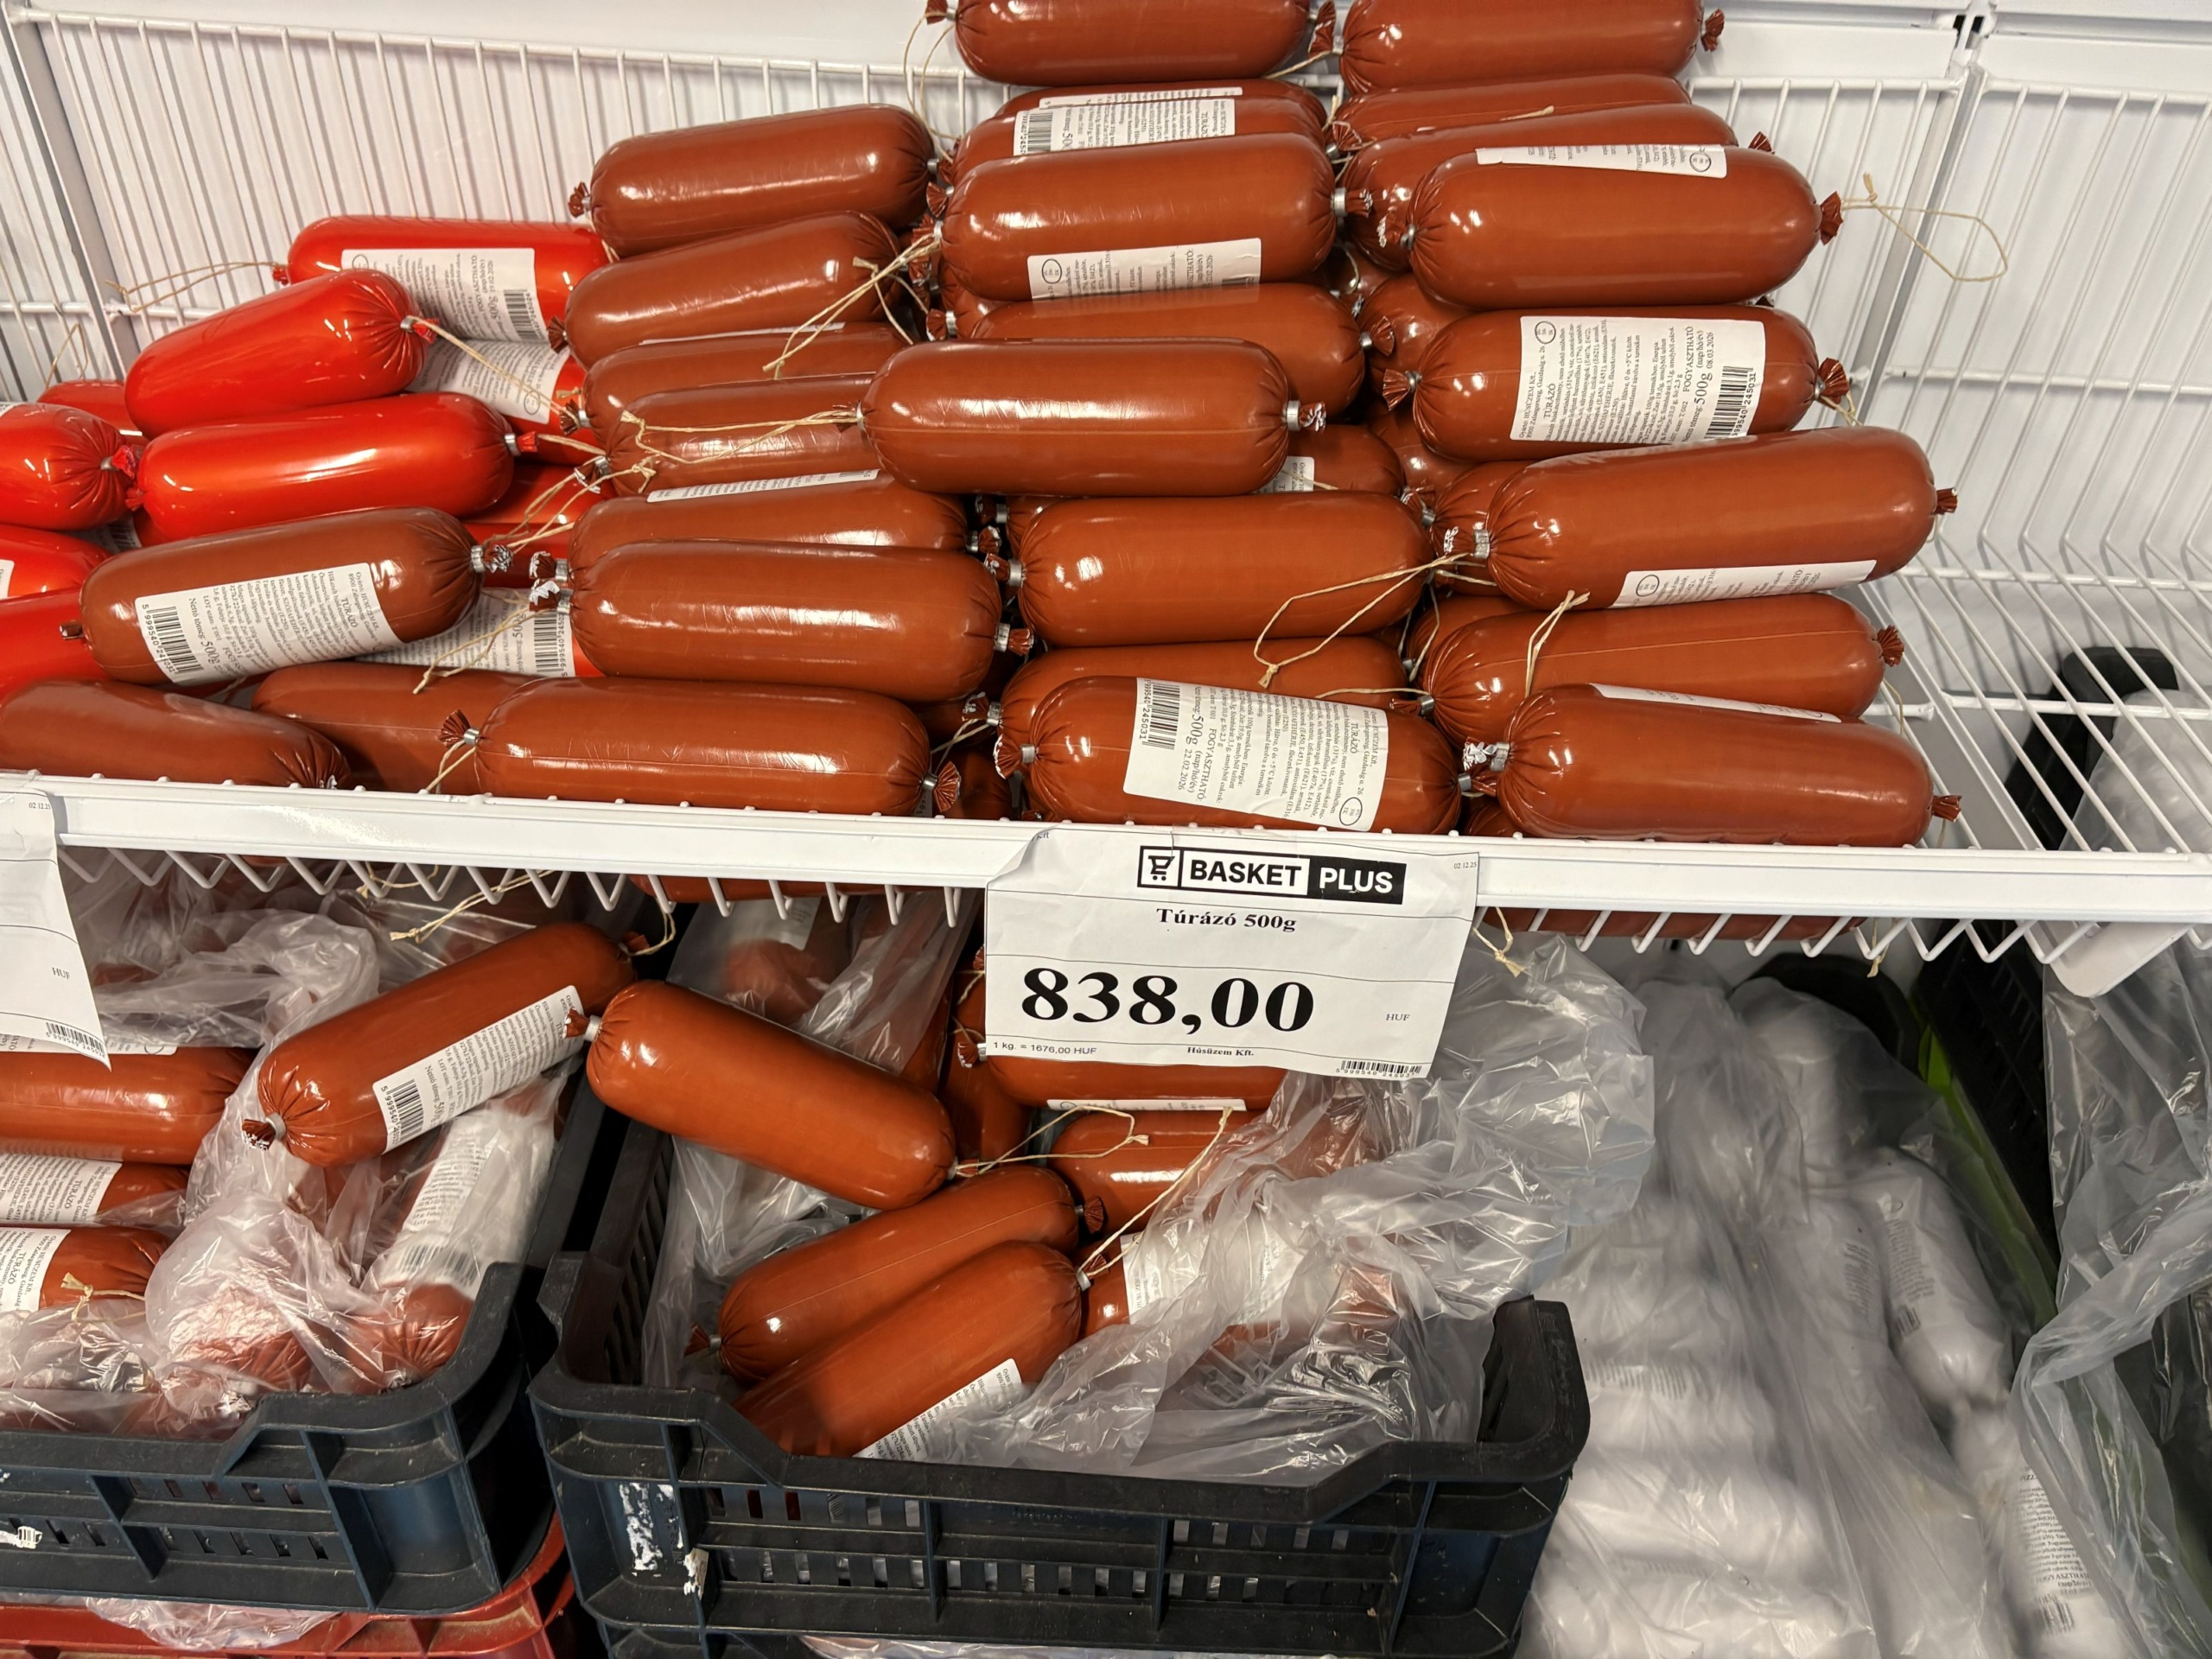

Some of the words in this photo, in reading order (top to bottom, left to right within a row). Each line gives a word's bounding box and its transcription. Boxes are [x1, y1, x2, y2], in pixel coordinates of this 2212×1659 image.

[1705, 331, 1713, 369] 08.03.2026
[1541, 383, 1556, 418] TÚRÁZÓ
[1692, 372, 1712, 404] 500g
[1743, 372, 1757, 405] 245031
[339, 597, 359, 628] TÚRÁZÓ
[143, 614, 160, 646] 999540
[188, 597, 199, 617] Nettó
[199, 639, 221, 665] 500g
[1138, 707, 1150, 740] 245031
[1185, 714, 1205, 746] 500g
[1349, 721, 1359, 754] TÚRÁZÓ
[1177, 747, 1192, 791] 22.02.2026
[1186, 749, 1203, 793] (nap/hó/év)
[1191, 859, 1301, 887] BASKET
[1319, 867, 1393, 893] PLUS
[1157, 908, 1236, 927] Túrázó
[1244, 913, 1297, 933] 500g
[52, 967, 70, 980] HUF
[1022, 967, 1314, 1036] 838,00
[1001, 1042, 1017, 1051] kg.
[1030, 1045, 1071, 1055] 1676,00
[1187, 1046, 1232, 1056] Húsüzem
[1235, 1048, 1255, 1057] Kft.
[63, 1179, 83, 1209] TÚRÁZÓ
[6, 1251, 28, 1284] TÚRÁZÓ
